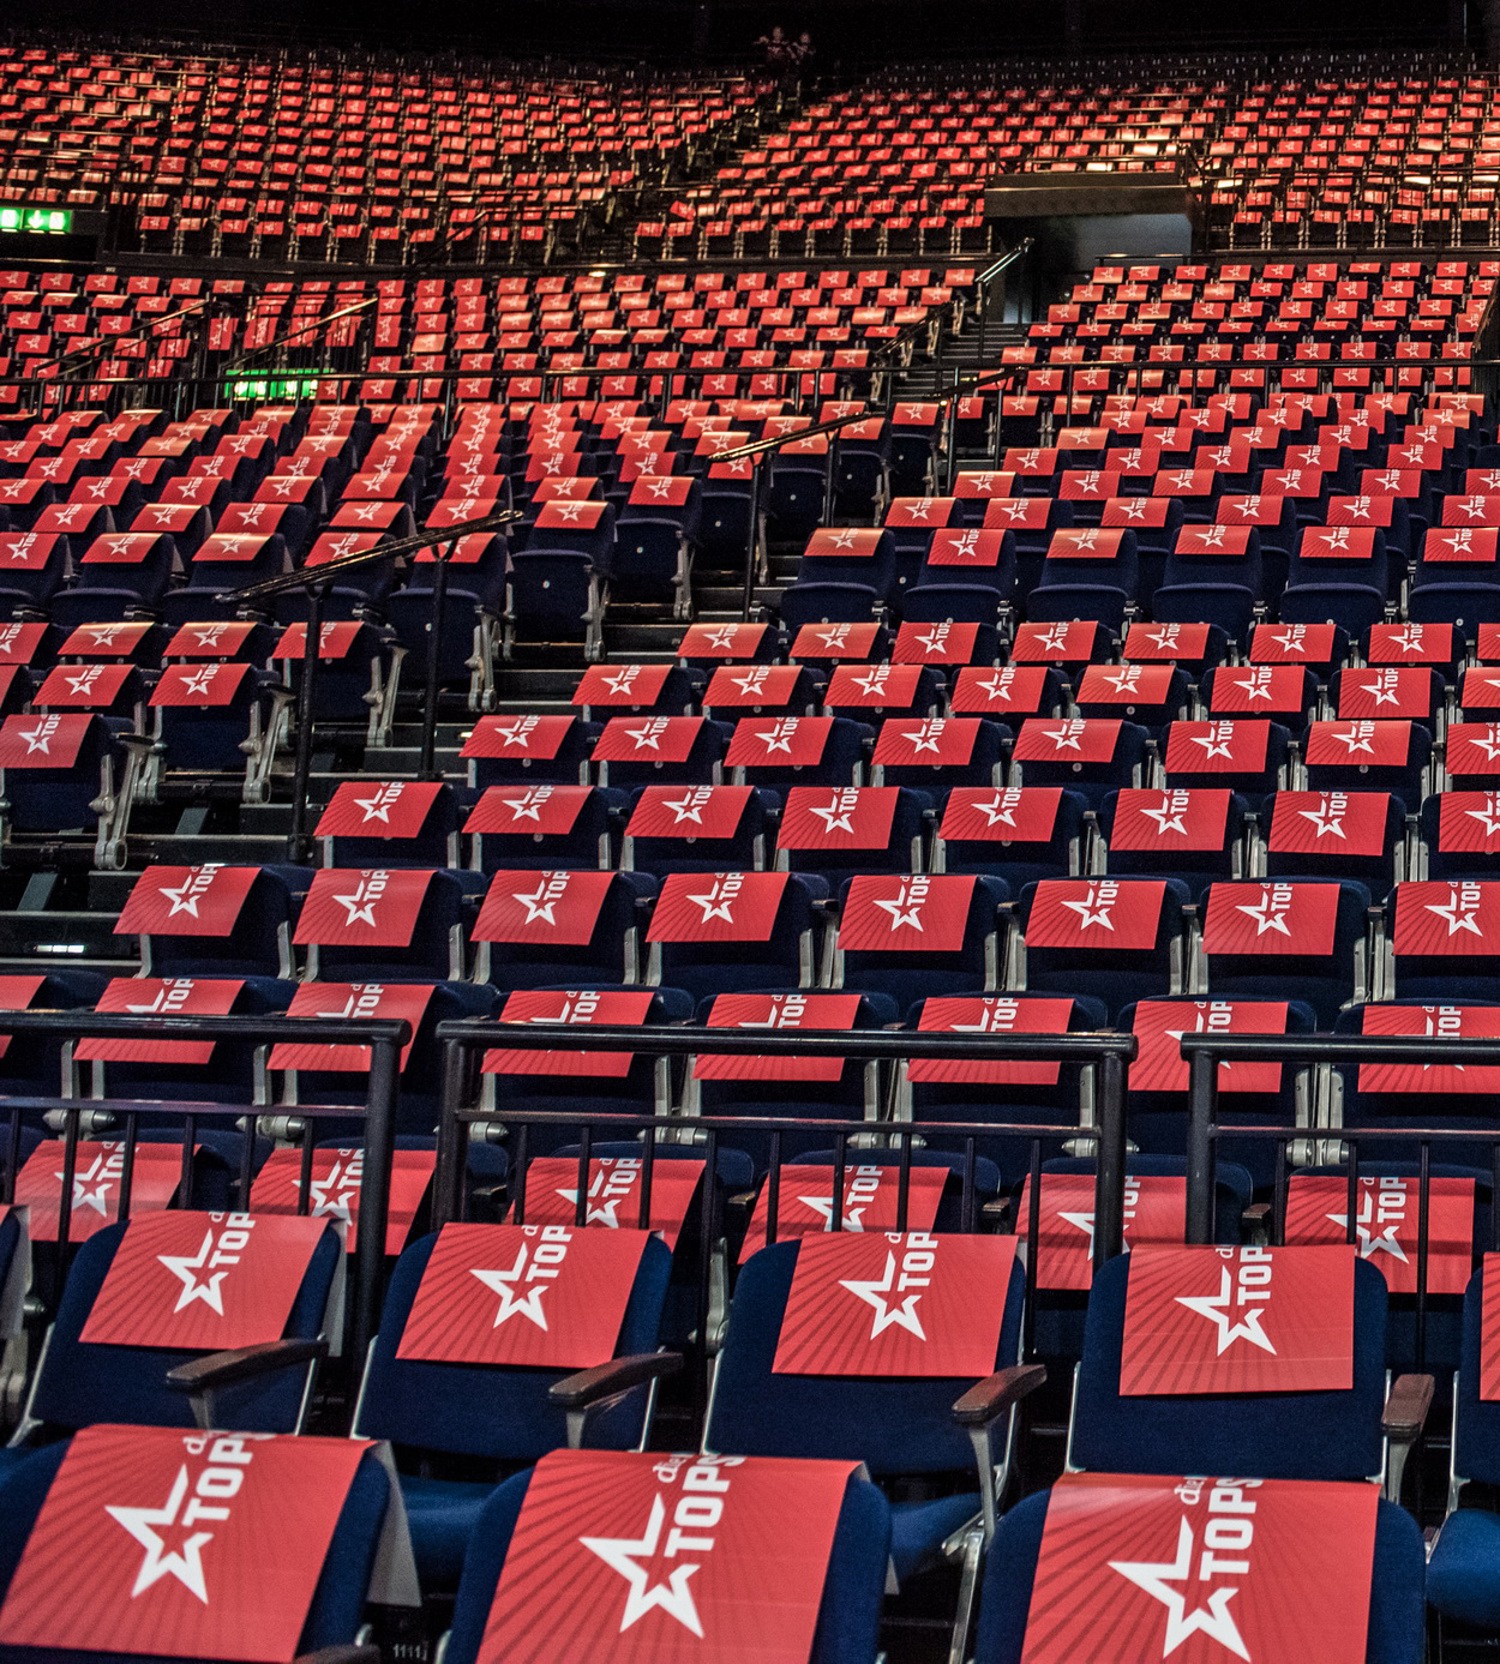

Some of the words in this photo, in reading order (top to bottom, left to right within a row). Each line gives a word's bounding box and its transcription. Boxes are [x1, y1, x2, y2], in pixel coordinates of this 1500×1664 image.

[42, 714, 60, 736] TOP
[520, 715, 539, 731] TOP
[650, 716, 669, 734] TOP
[780, 717, 799, 737] TOP
[928, 718, 945, 736] TOP
[1068, 719, 1086, 735] TOP
[1217, 720, 1234, 742] TOP
[1358, 720, 1376, 738] TOP
[381, 782, 404, 804] TOP
[530, 786, 554, 804] TOP
[692, 785, 713, 806] TOP
[838, 786, 860, 812] TOP
[1001, 787, 1022, 808] TOP
[1170, 789, 1190, 814] TOP
[1328, 792, 1348, 817] TOP
[190, 866, 217, 894] TOP
[362, 870, 389, 902] TOP
[543, 871, 570, 900] TOP
[719, 872, 744, 900] TOP
[906, 876, 930, 906] TOP
[1096, 880, 1119, 907] TOP
[1270, 883, 1292, 912] TOP
[1460, 882, 1481, 911] TOP
[161, 978, 195, 1012] TOP
[353, 983, 385, 1018] TOP
[570, 991, 600, 1024] TOP
[778, 994, 807, 1028] TOP
[991, 997, 1019, 1033] TOP
[1207, 1001, 1233, 1034] TOP
[1438, 1005, 1462, 1038] TOP
[602, 1158, 643, 1197] TOP
[847, 1165, 884, 1206] TOP
[1377, 1176, 1408, 1222] TOP
[208, 1212, 256, 1269] TOP
[525, 1225, 573, 1283] TOP
[899, 1231, 939, 1291] TOP
[1237, 1246, 1273, 1306] TOP
[182, 1431, 276, 1526] TOP
